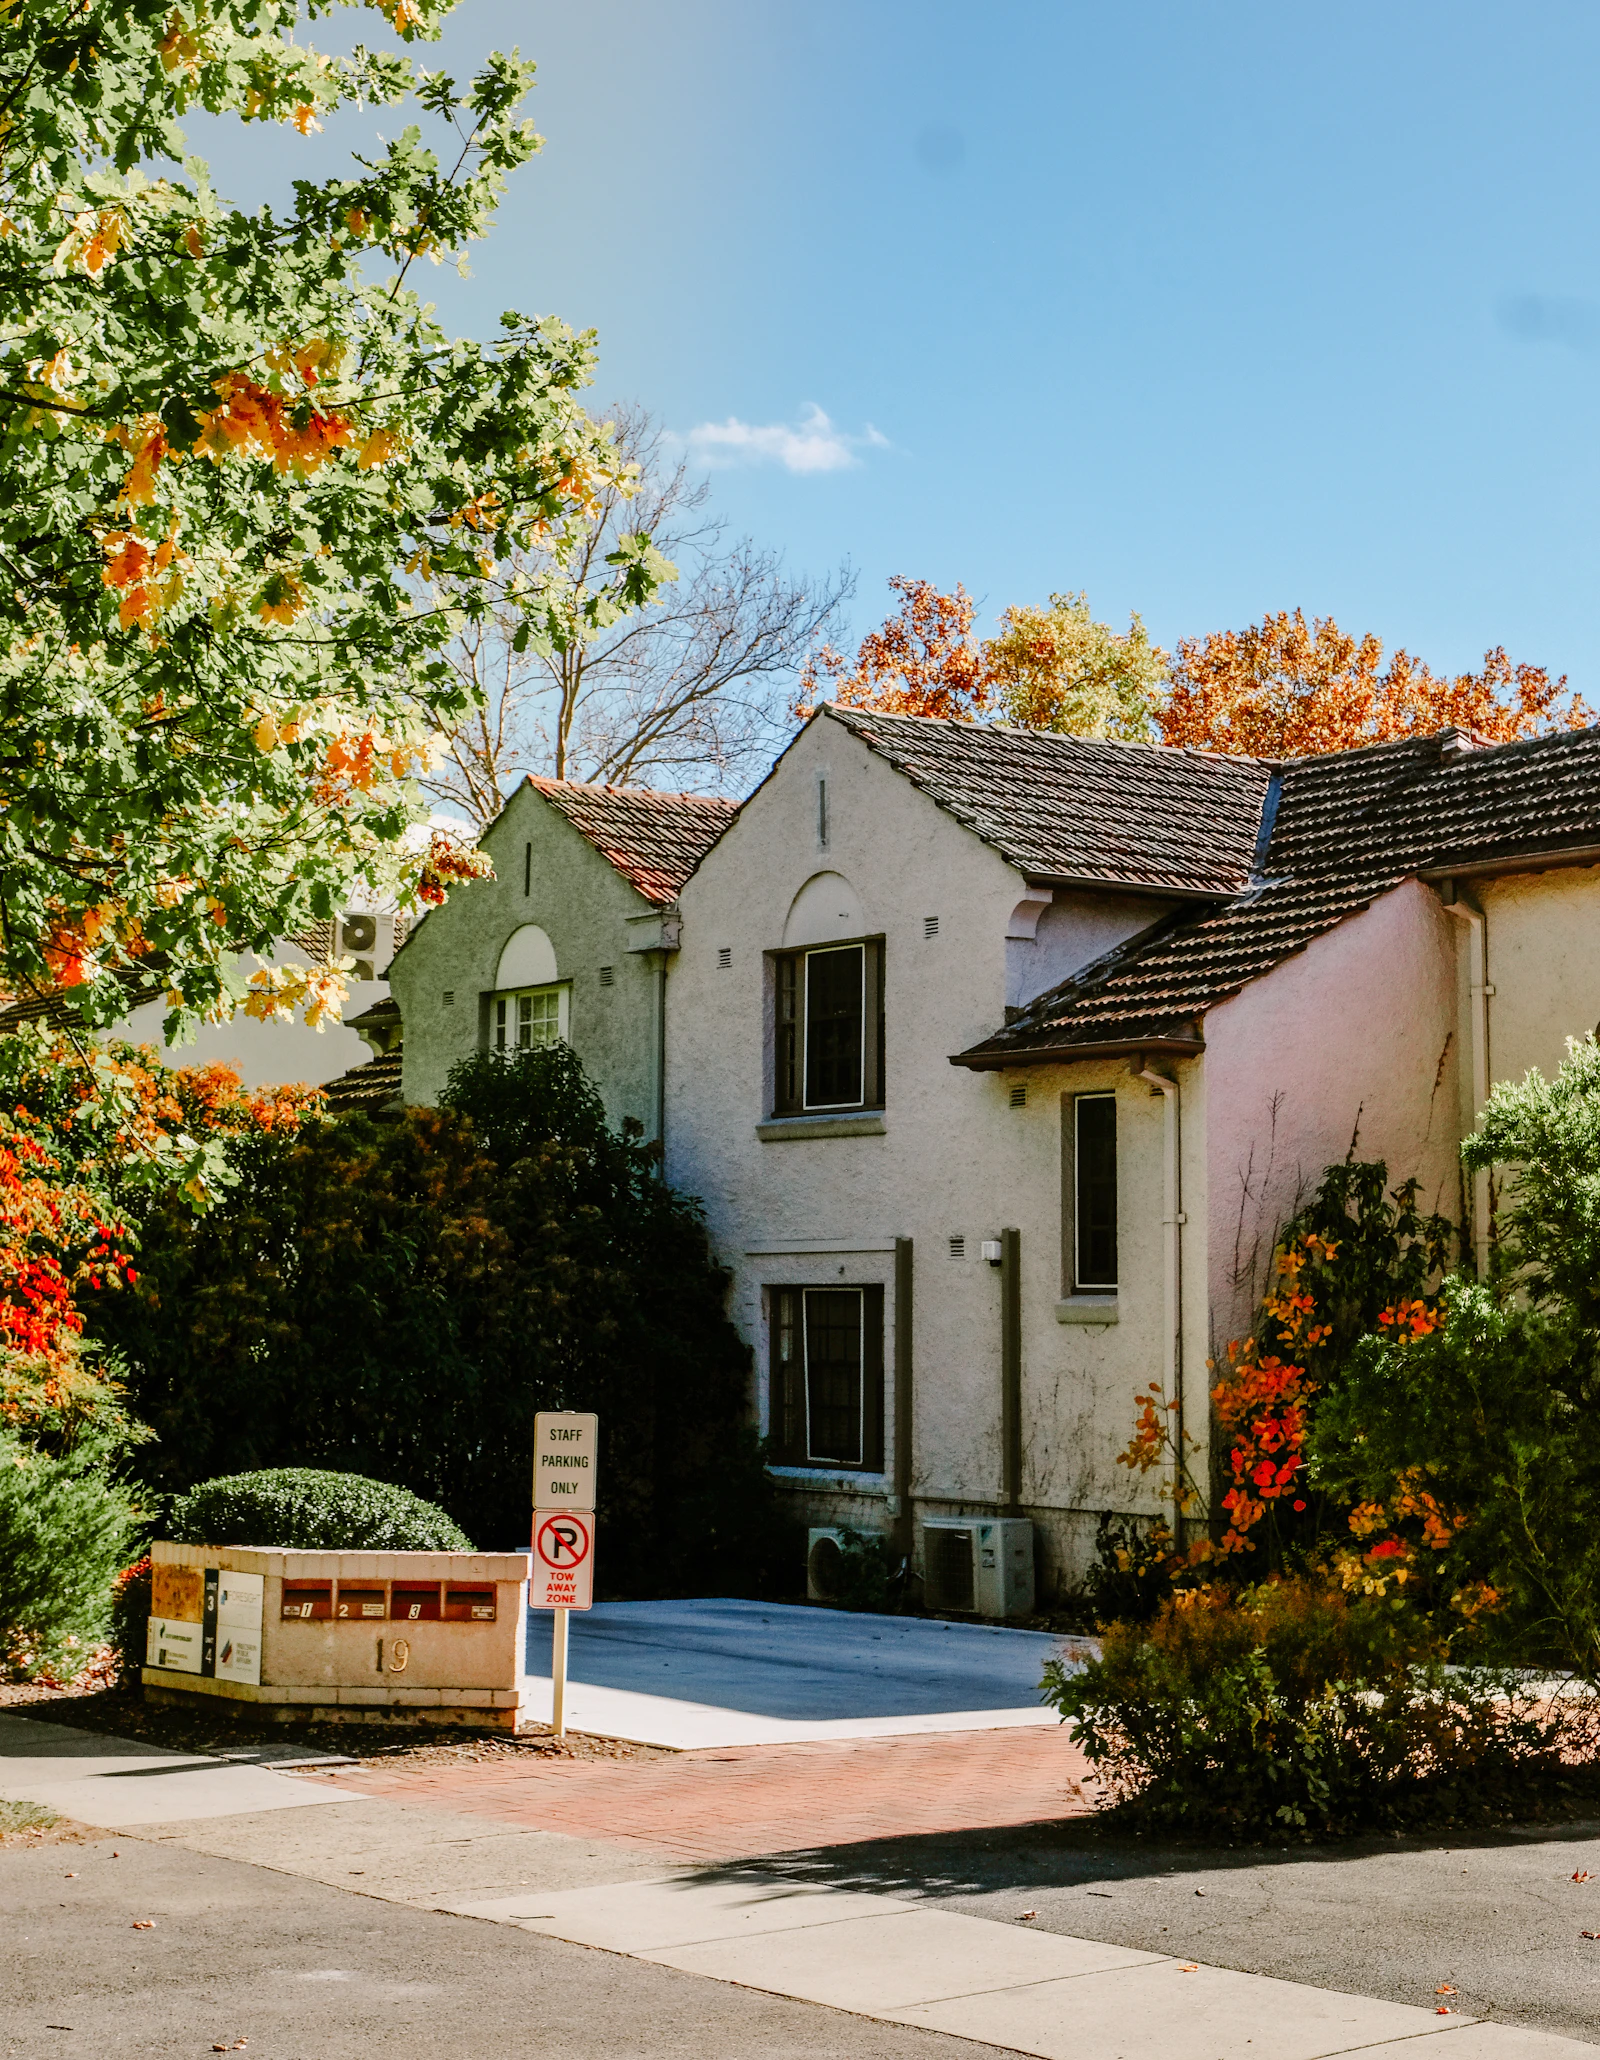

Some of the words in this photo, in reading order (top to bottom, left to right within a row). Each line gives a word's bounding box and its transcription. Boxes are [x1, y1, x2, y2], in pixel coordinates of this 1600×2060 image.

[550, 1429, 582, 1441] STAFF
[542, 1455, 589, 1468] PARKING
[551, 1481, 578, 1494] ONLY
[554, 1527, 578, 1558] P
[550, 1572, 574, 1580] TOW
[546, 1583, 577, 1592] AWAY
[207, 1595, 215, 1612] 3
[546, 1594, 576, 1603] ZONE
[339, 1604, 348, 1617] 2
[410, 1605, 418, 1618] 3
[205, 1648, 212, 1664] 4
[376, 1638, 410, 1673] 19
